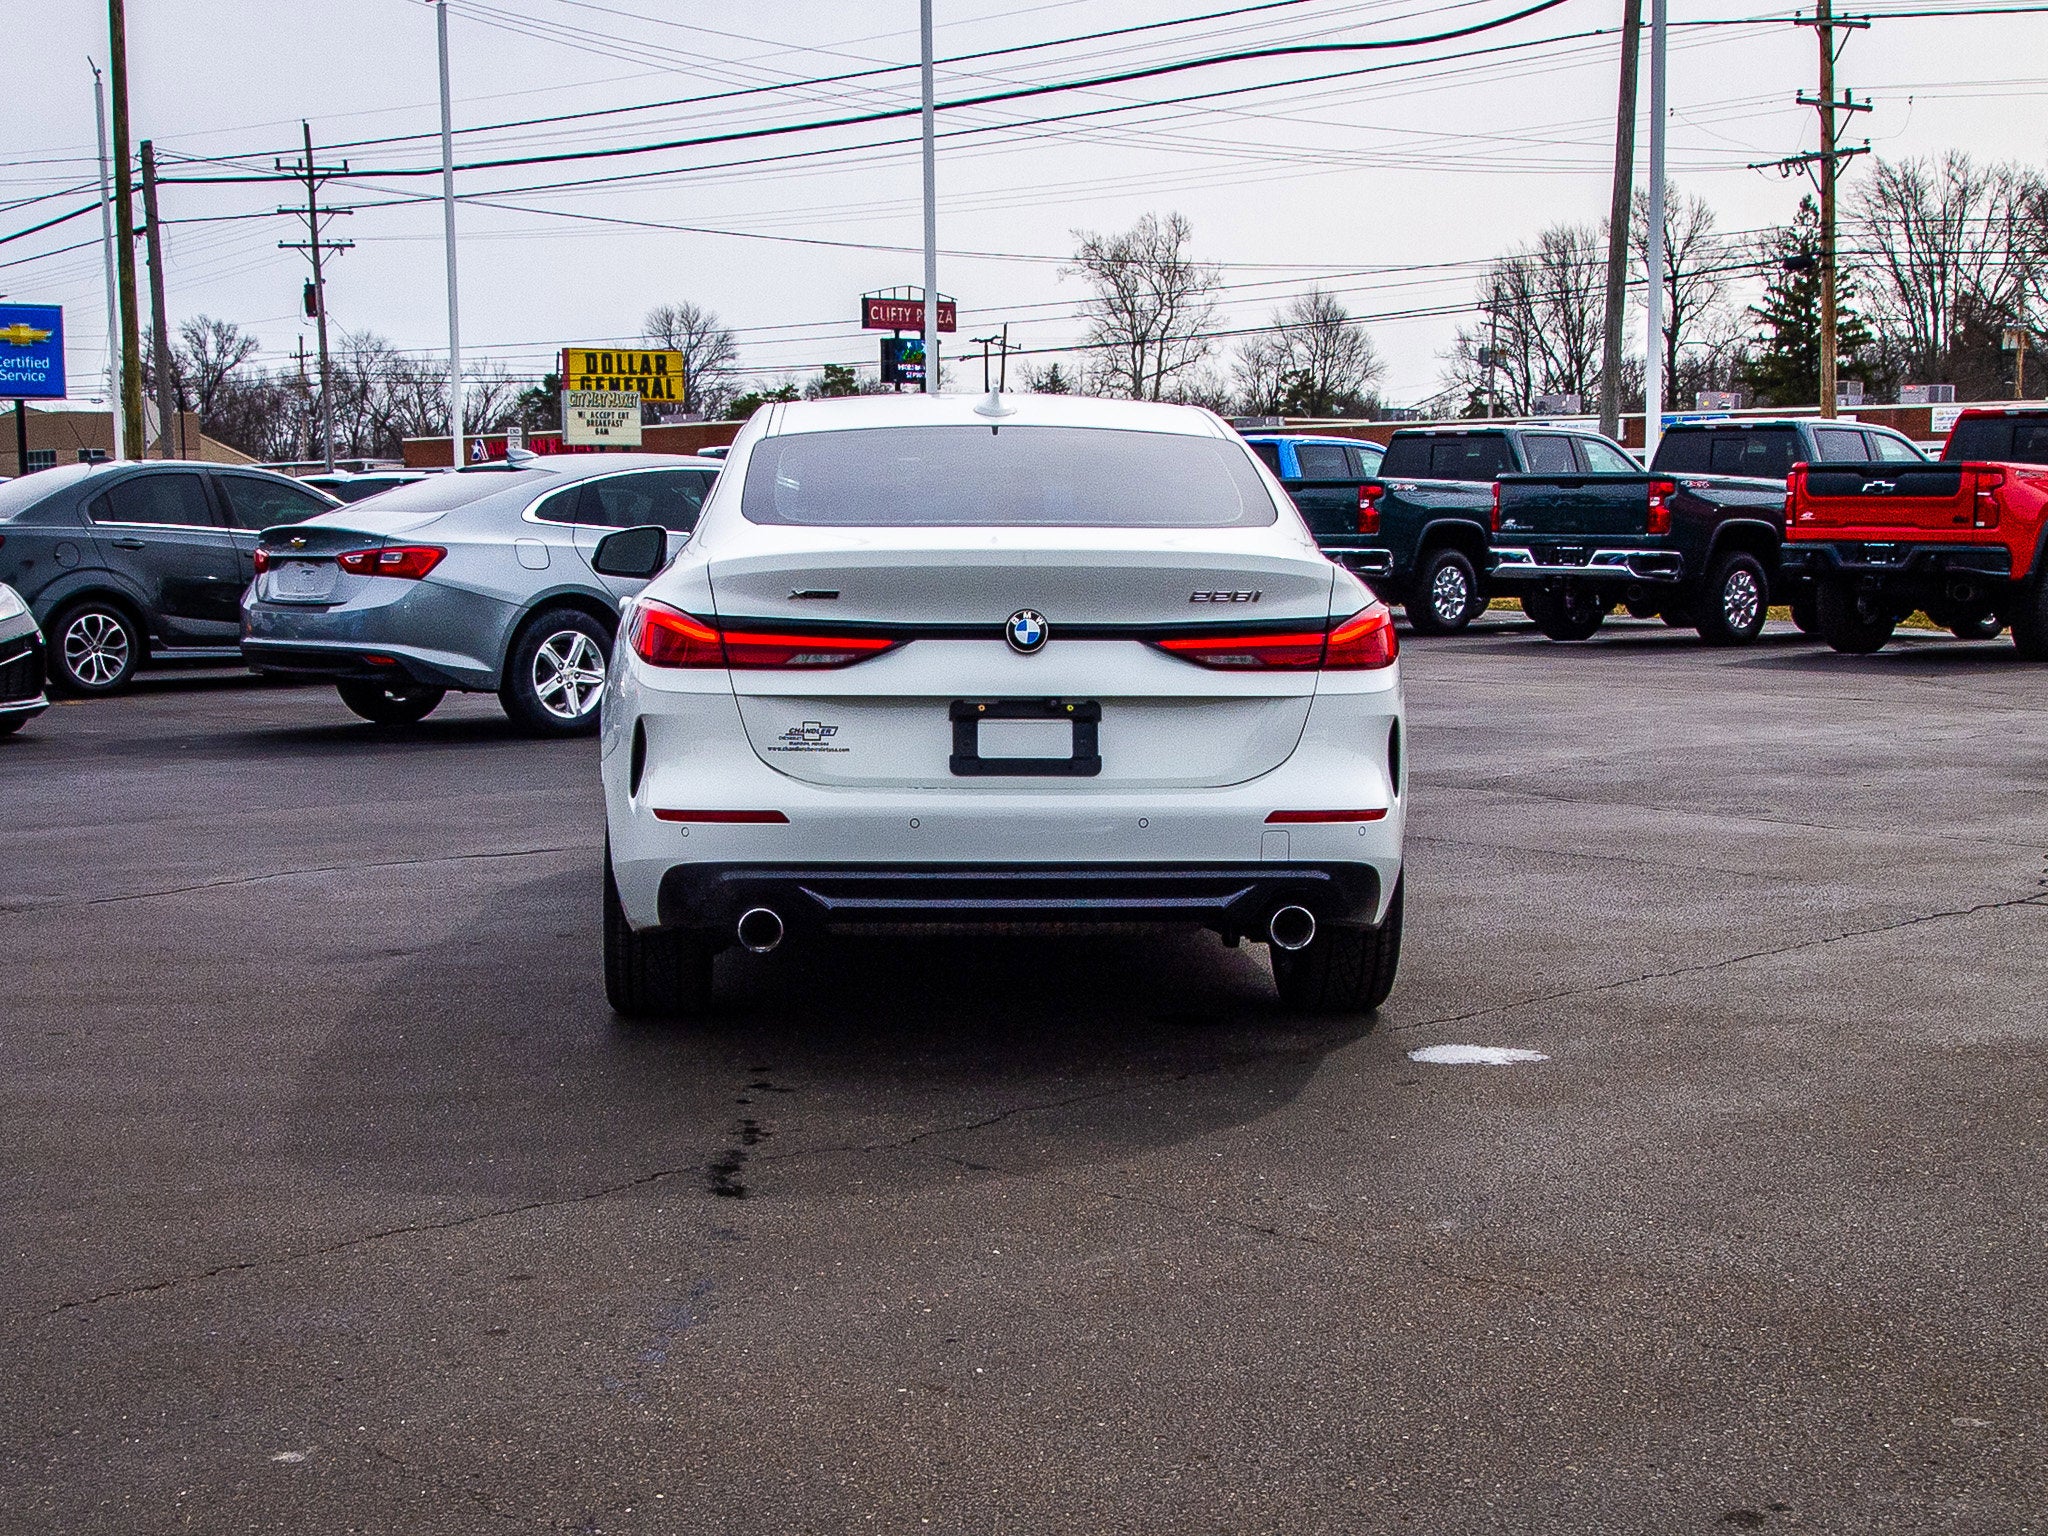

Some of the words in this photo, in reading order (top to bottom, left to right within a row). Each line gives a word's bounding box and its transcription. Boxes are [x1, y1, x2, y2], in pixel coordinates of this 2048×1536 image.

[870, 306, 911, 322] CLIFTY
[916, 308, 954, 324] PZA
[585, 352, 668, 376] DOLLAR
[0, 369, 46, 382] Service
[590, 411, 615, 419] ACCEPT
[586, 419, 624, 427] BREAKFAST
[1010, 611, 1046, 625] BMW
[788, 726, 832, 735] CHANDLER
